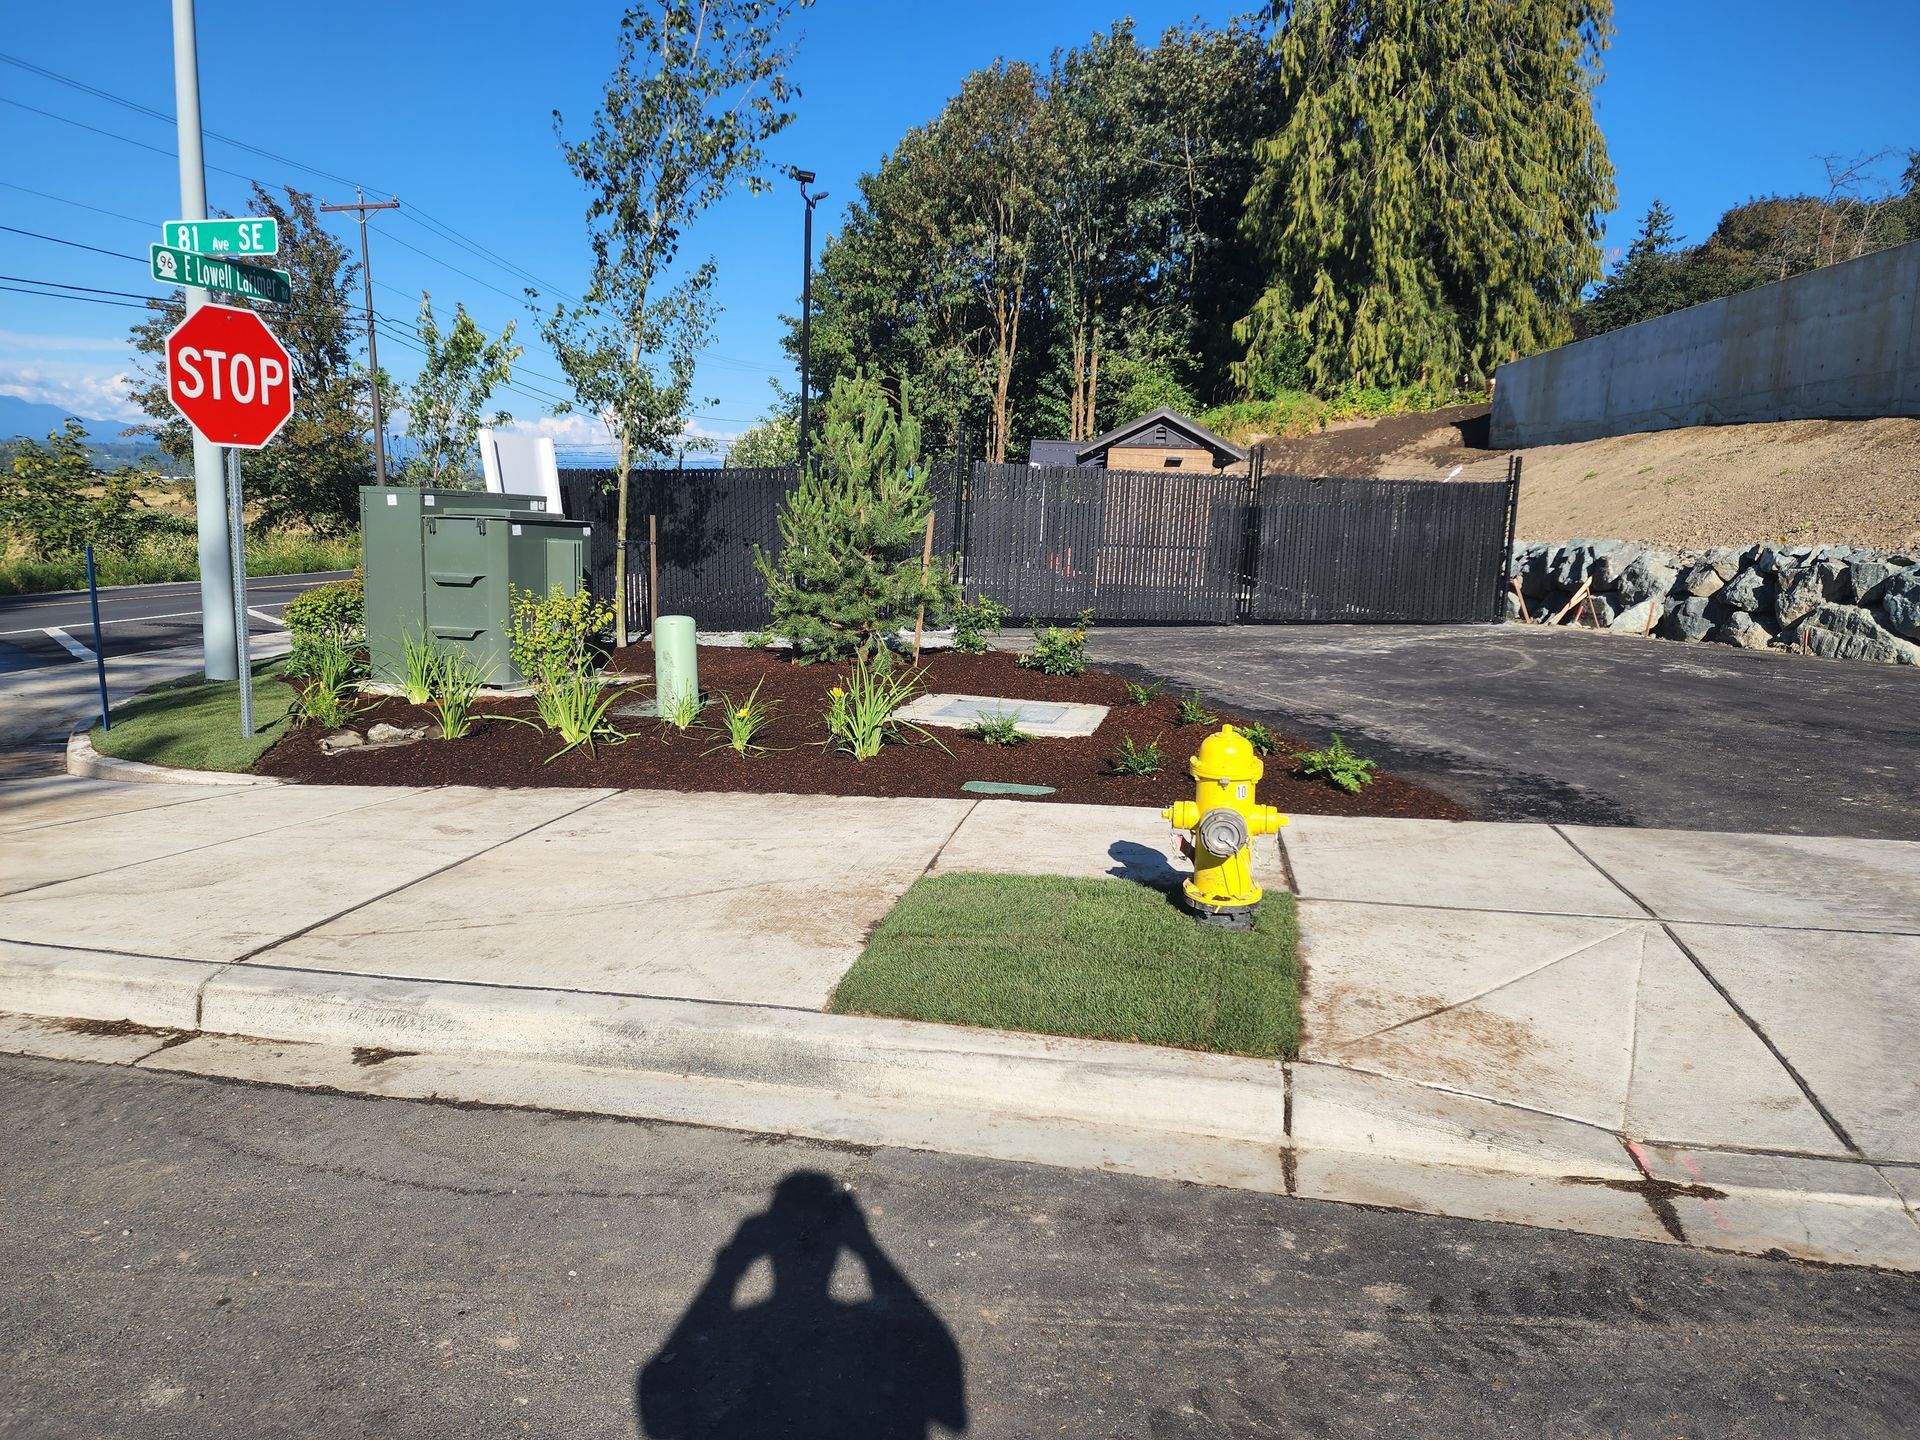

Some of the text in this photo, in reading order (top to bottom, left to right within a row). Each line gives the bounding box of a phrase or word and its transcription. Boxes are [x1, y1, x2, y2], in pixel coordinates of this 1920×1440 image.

[178, 223, 264, 251] 81 Ave SE
[159, 255, 174, 269] 96
[184, 255, 192, 282] E
[196, 257, 232, 290] Lowell
[236, 265, 276, 297] Larimer
[177, 346, 284, 405] STOP
[1237, 785, 1246, 798] 10
